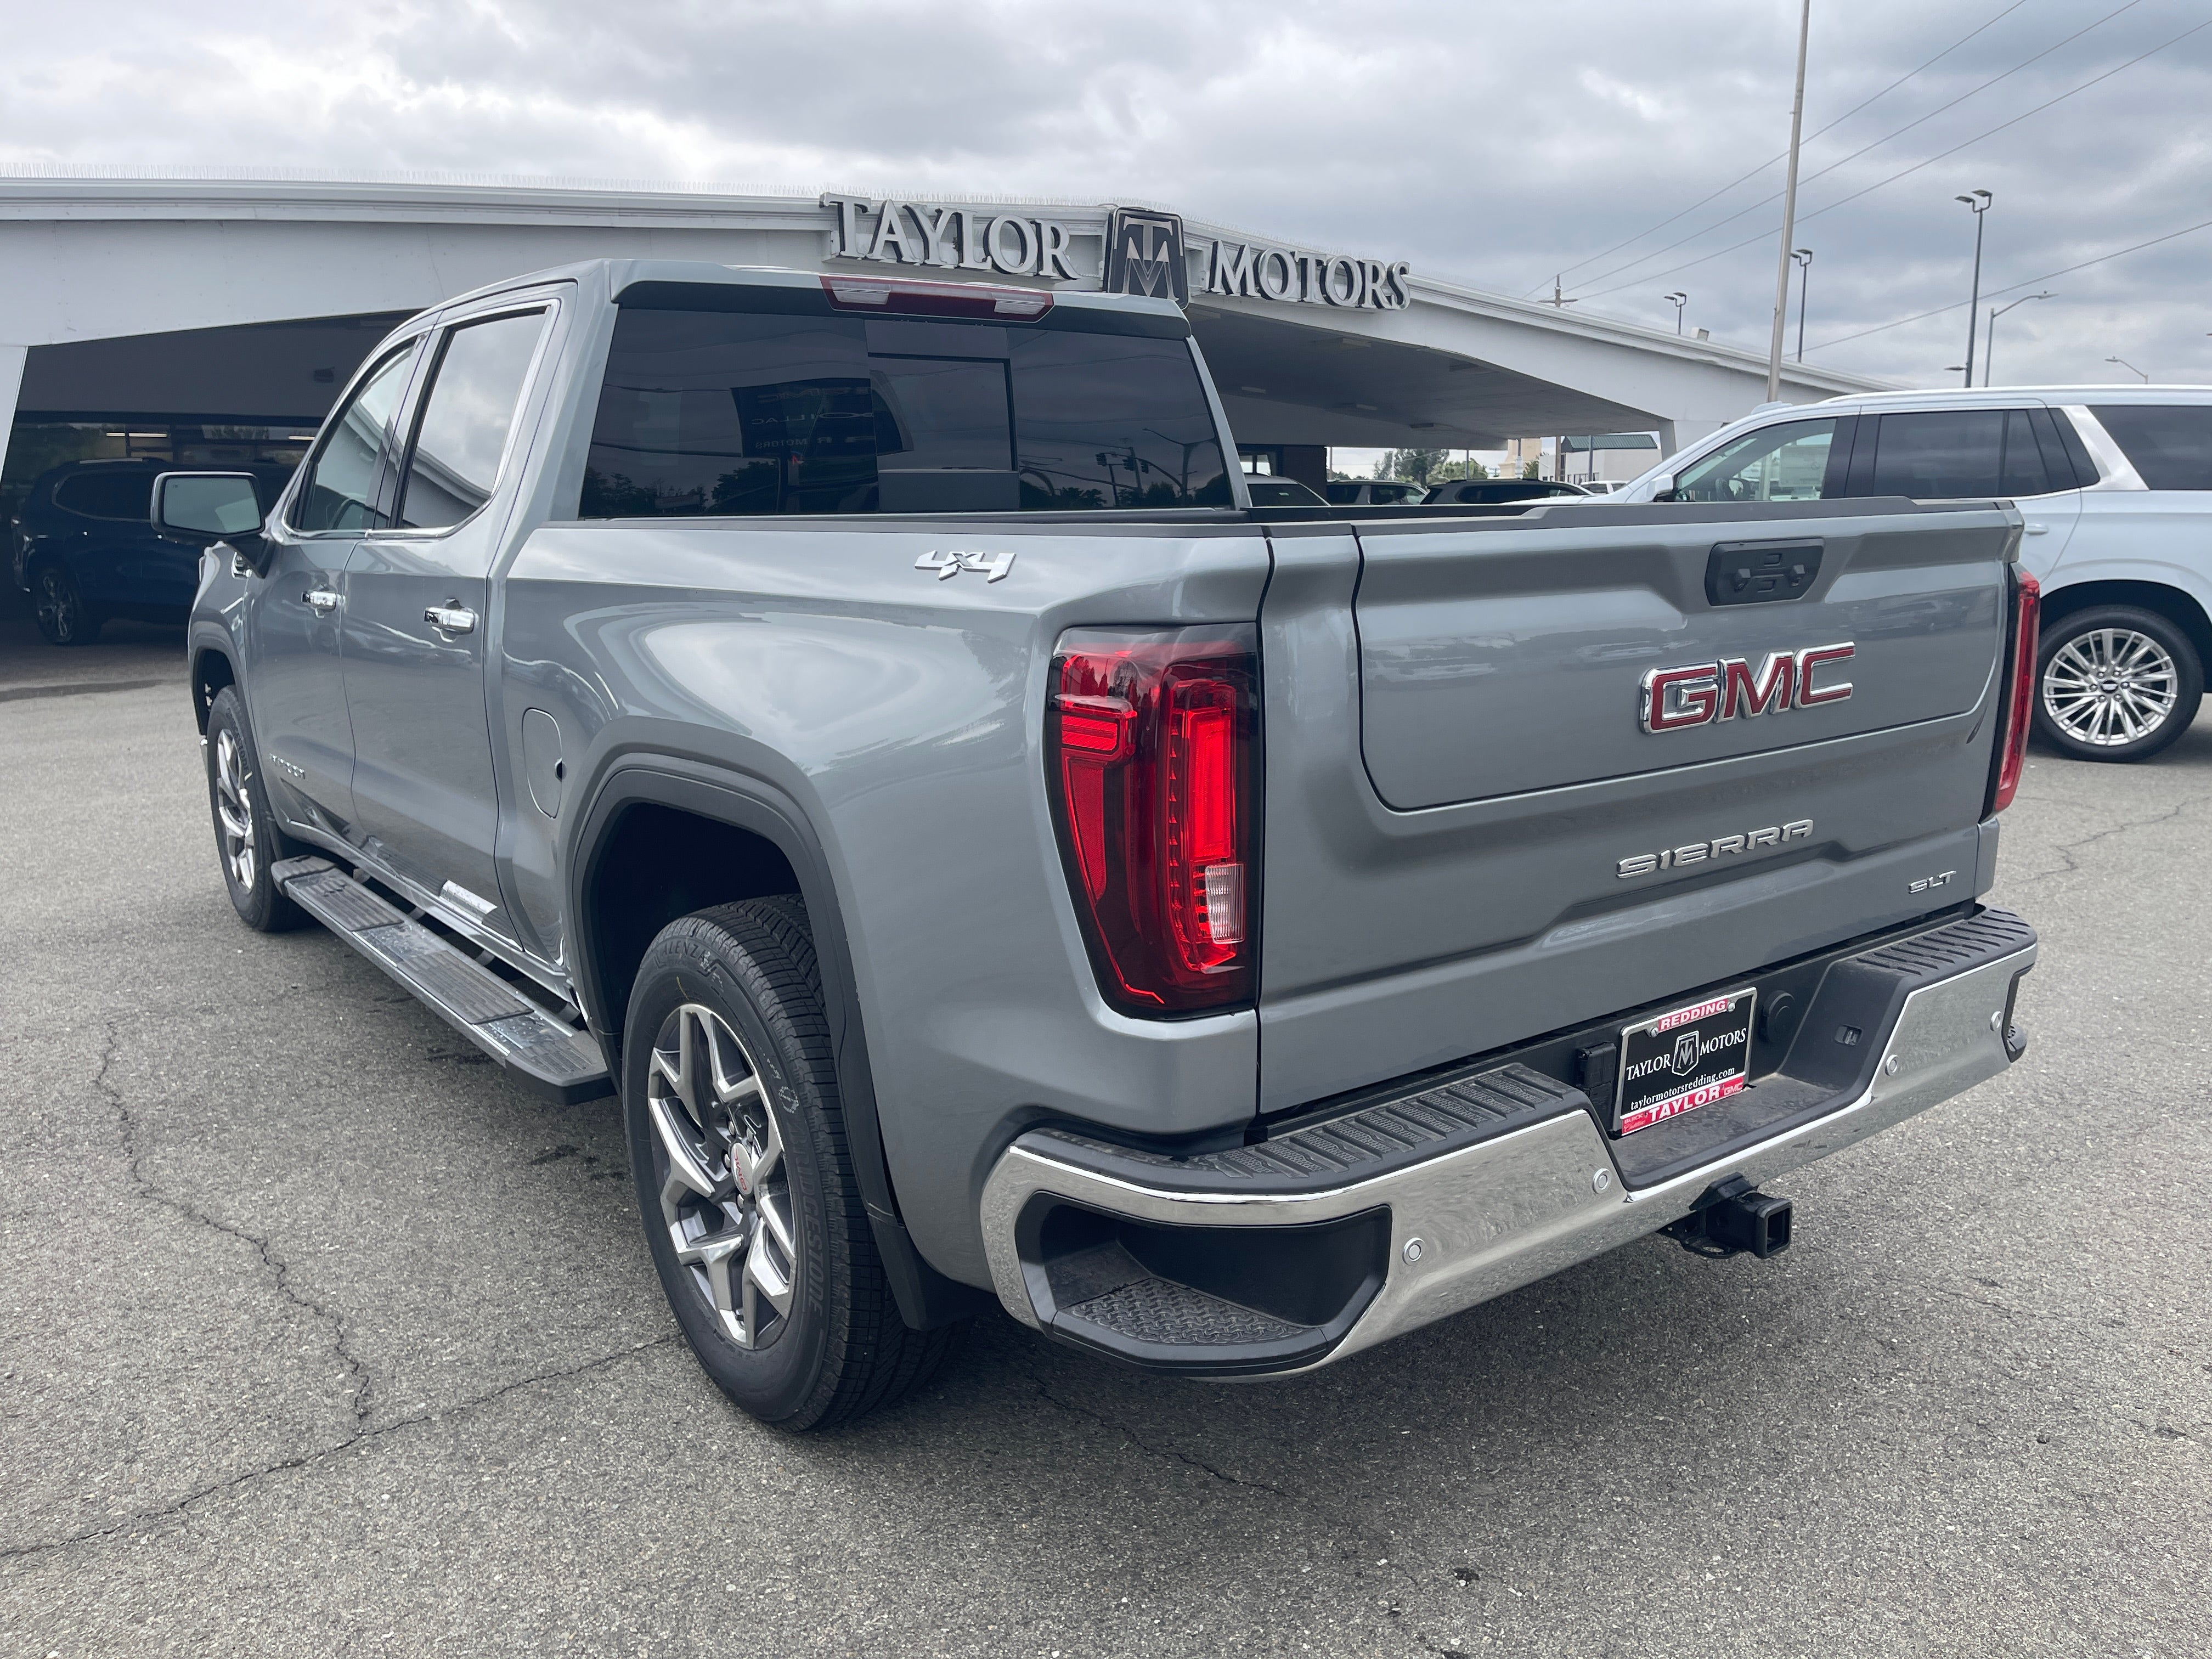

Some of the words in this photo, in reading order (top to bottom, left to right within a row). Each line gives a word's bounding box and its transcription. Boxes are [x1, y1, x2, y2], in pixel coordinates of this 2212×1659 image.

[820, 191, 1081, 280] TAYLOR
[1209, 239, 1410, 311] MOTORS
[1640, 641, 1857, 734] GMC
[1616, 819, 1814, 879] SIERRA
[1908, 871, 1957, 894] SLT
[1660, 1000, 1726, 1030] REDDING
[1626, 1053, 1672, 1081] TAYLOR
[1699, 1028, 1747, 1056] MOTORS
[1630, 1066, 1735, 1110] taylormotorsredding.com
[1649, 1085, 1720, 1122] TAYLOR
[1723, 1082, 1743, 1097] GMC
[788, 1120, 823, 1317] BRIDGESTONE
